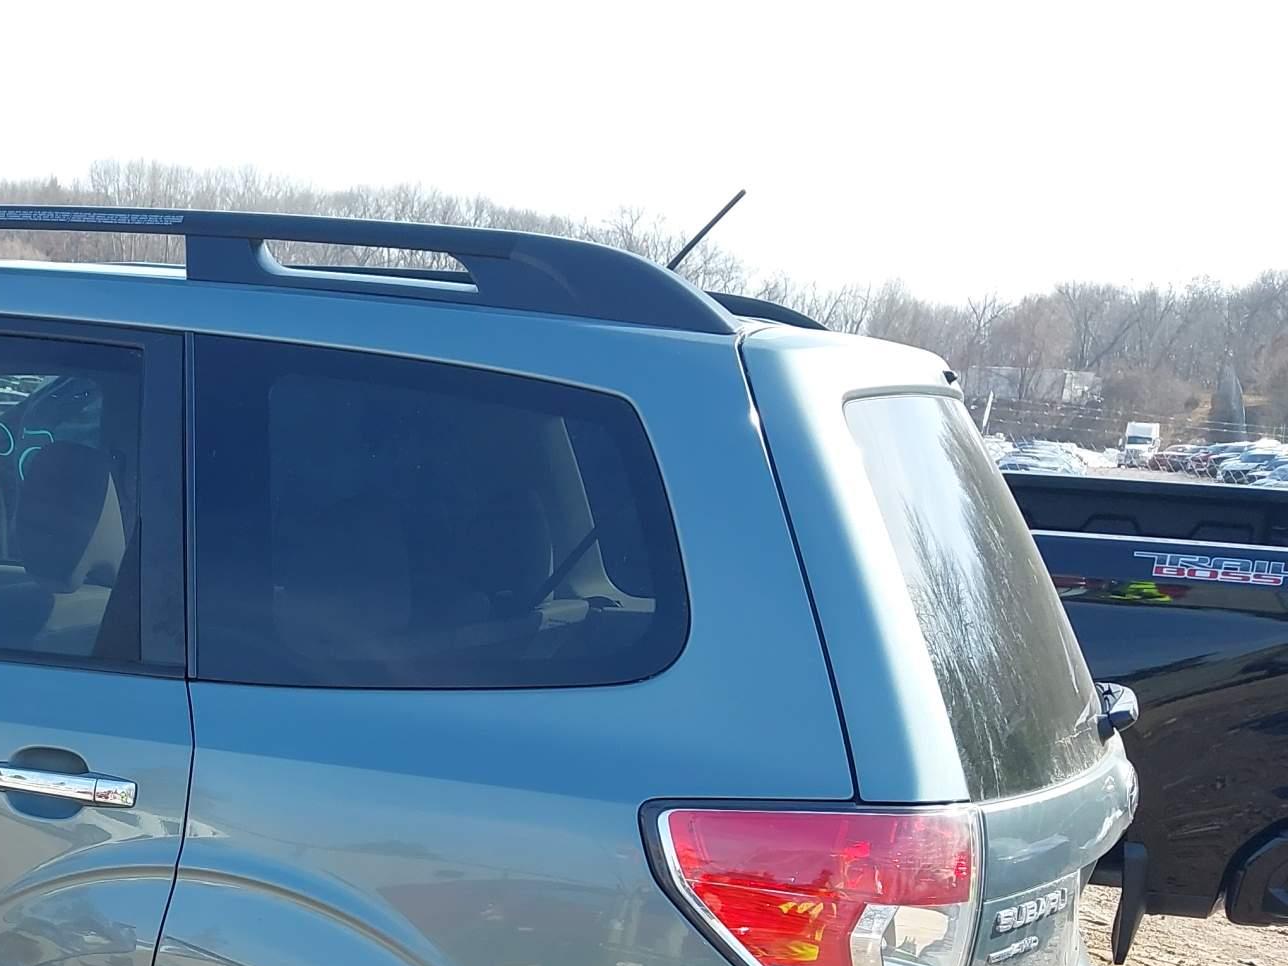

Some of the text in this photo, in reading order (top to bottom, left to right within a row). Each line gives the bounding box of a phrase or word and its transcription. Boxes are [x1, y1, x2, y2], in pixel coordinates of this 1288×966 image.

[1133, 551, 1288, 577] TRAIL
[1152, 564, 1284, 587] BOSS
[993, 887, 1068, 934] SUBARU
